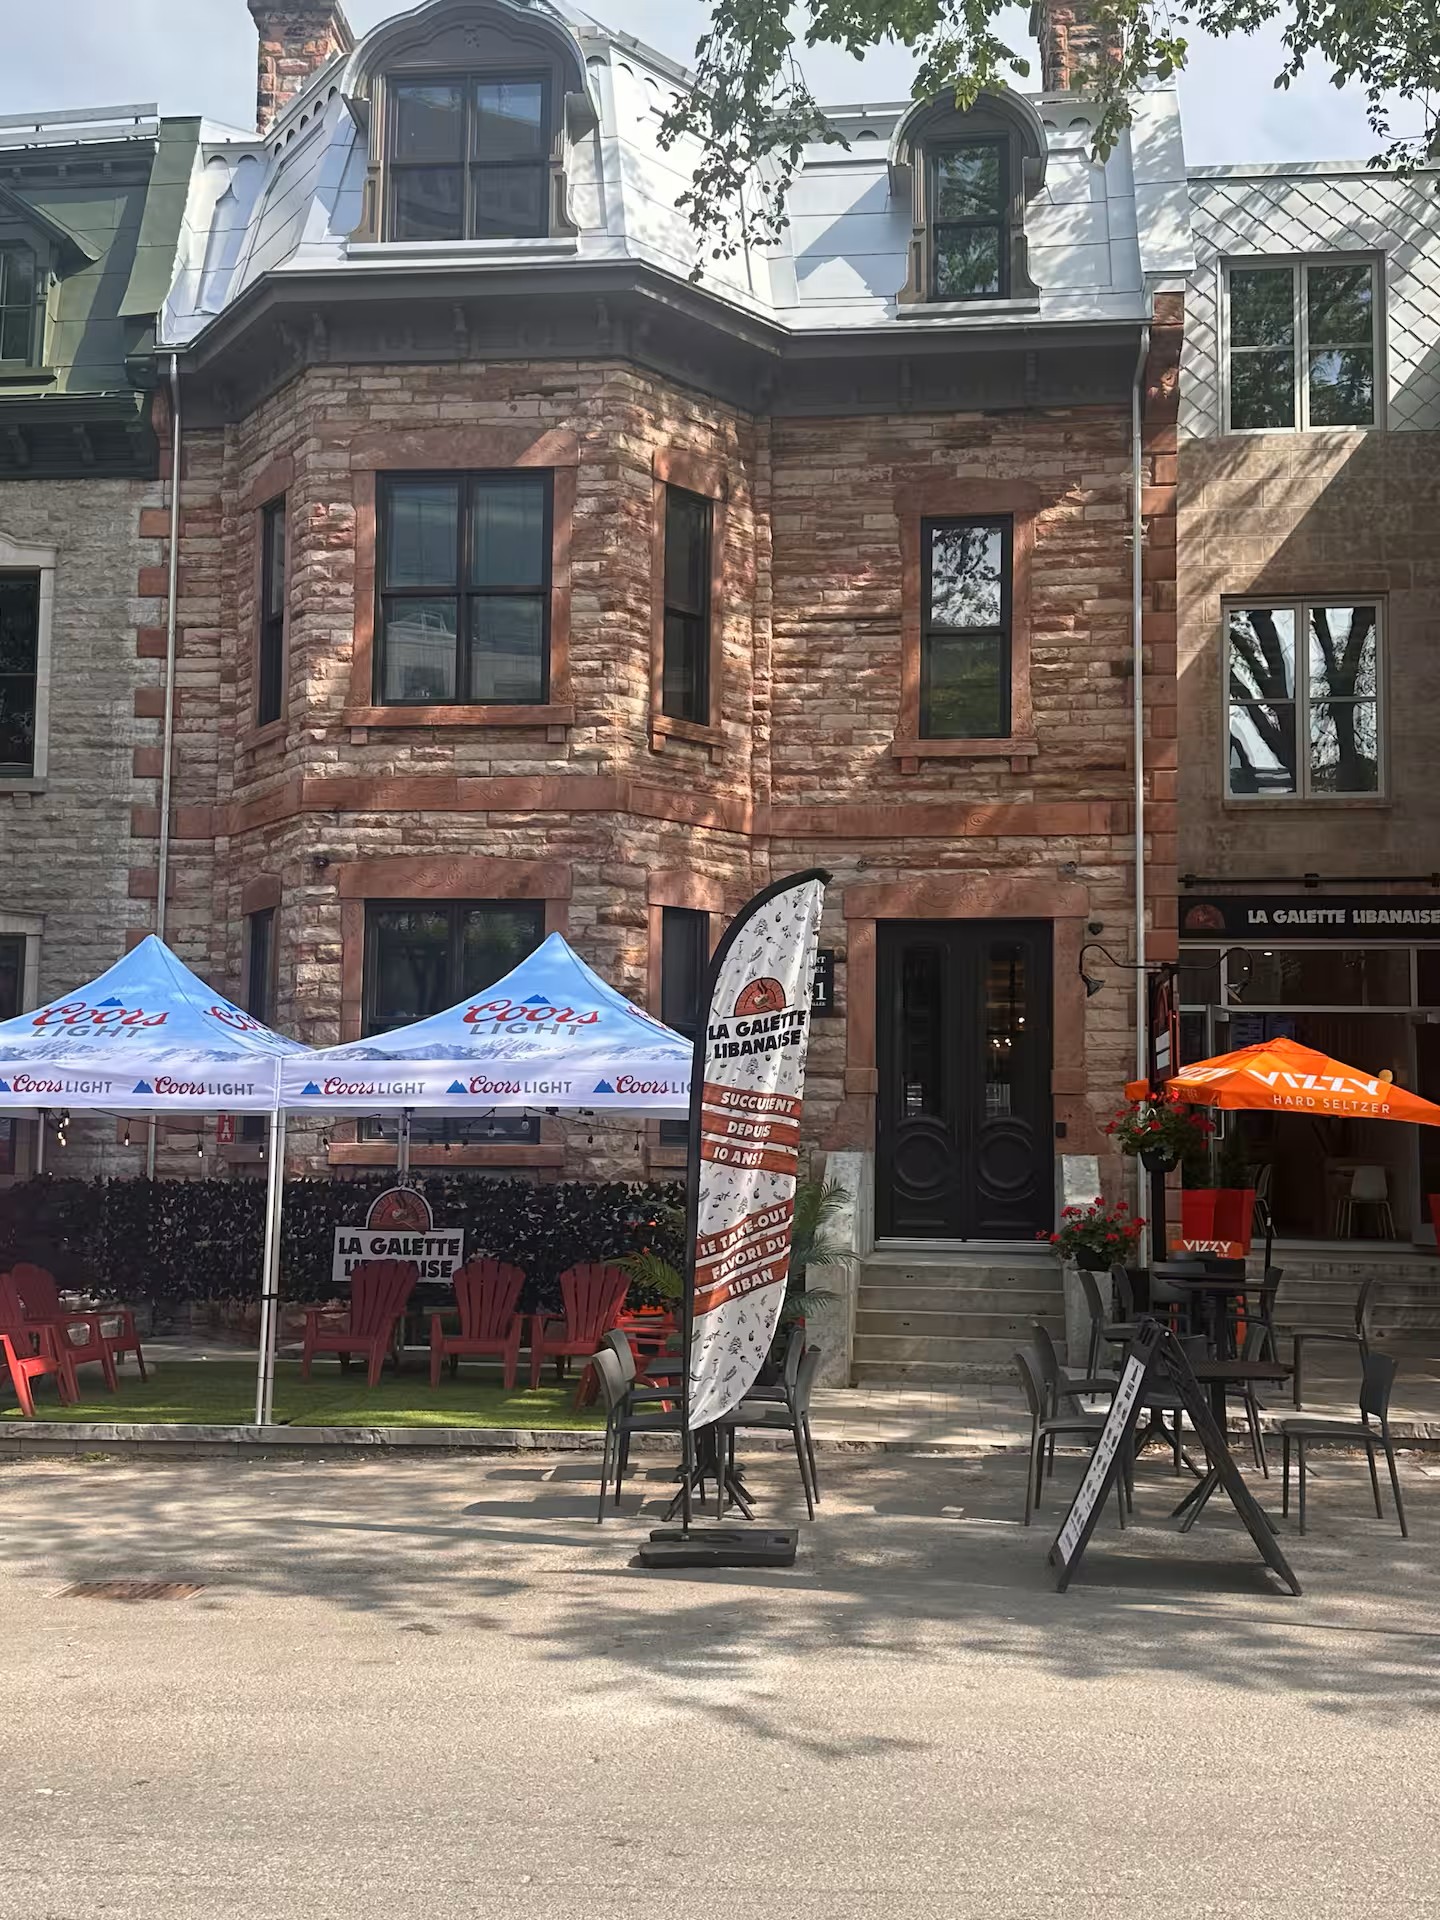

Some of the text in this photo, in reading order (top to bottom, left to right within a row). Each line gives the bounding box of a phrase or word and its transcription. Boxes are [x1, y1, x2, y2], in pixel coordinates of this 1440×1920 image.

[1248, 909, 1440, 924] LA GALETTE LIBANAISE
[32, 1002, 170, 1026] Coors
[463, 999, 602, 1024] Coors
[31, 1025, 148, 1038] LIGHT
[469, 1022, 583, 1036] LIGHT
[708, 1009, 807, 1041] LA GALETTE
[714, 1029, 802, 1059] LIBANAISE
[13, 1074, 113, 1094] Coors LIGHT
[154, 1075, 255, 1096] Coors LIGHT
[323, 1076, 426, 1095] Coors LIGHT
[469, 1075, 572, 1094] Coors LIGHT
[616, 1074, 669, 1094] Coors
[1246, 1068, 1381, 1096] VIZZY
[1272, 1094, 1391, 1114] HARD SELTZER
[712, 1146, 764, 1166] 10 ANS!
[700, 1206, 787, 1256] LE TAKE-OUT
[338, 1237, 460, 1256] LA GALETTE
[1182, 1239, 1232, 1253] VIZZY
[711, 1235, 786, 1280] FAVORI DU
[728, 1268, 774, 1297] LIBAN
